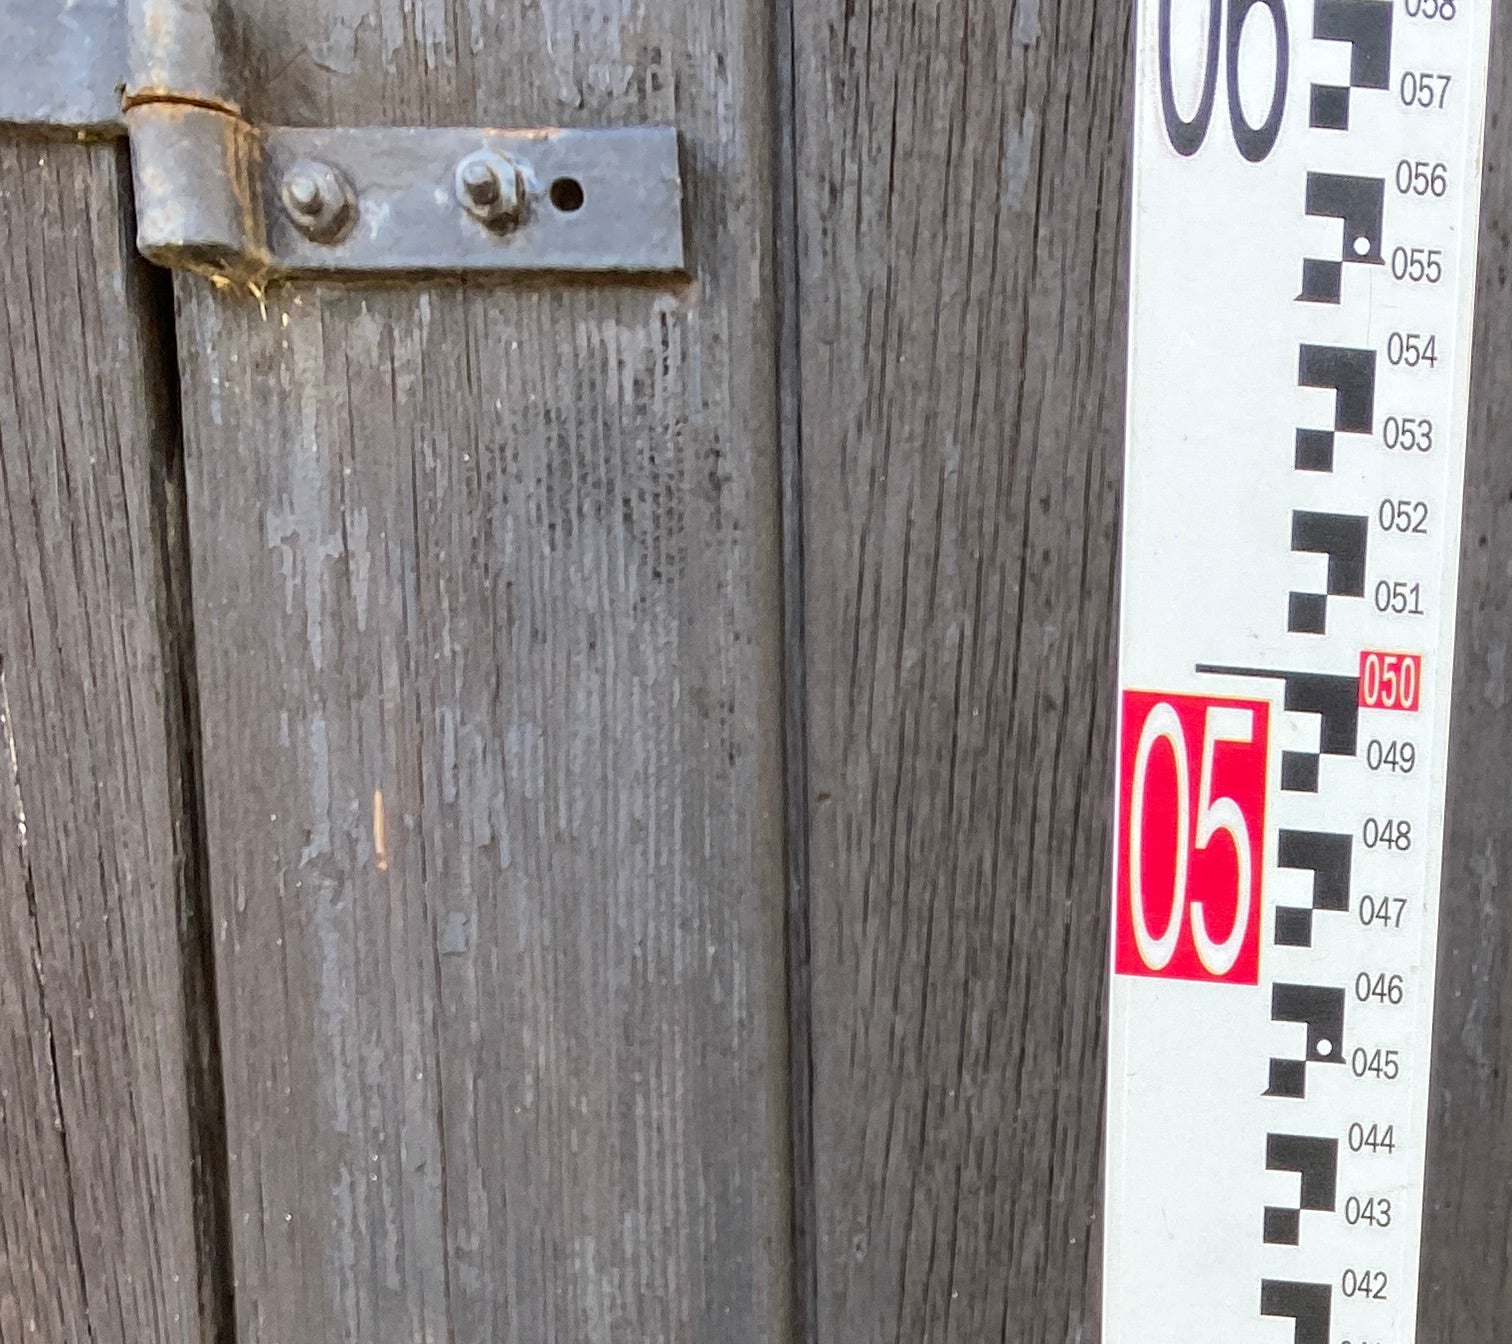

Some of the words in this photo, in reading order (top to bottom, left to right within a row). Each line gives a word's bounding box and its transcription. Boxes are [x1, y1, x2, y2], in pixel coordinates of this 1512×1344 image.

[1400, 71, 1451, 109] 057
[1396, 160, 1447, 197] 056
[1392, 246, 1441, 283] 055
[1387, 332, 1437, 368] 054
[1383, 416, 1432, 452] 053
[1379, 499, 1428, 534] 052
[1375, 580, 1423, 615] 051
[1362, 654, 1416, 707] 050
[1367, 739, 1415, 773] 049
[1132, 702, 1253, 973] 05
[1363, 818, 1411, 851] 048
[1359, 895, 1407, 928] 047
[1355, 972, 1403, 1004] 046
[1352, 1047, 1399, 1079] 045
[1349, 1122, 1395, 1154] 044
[1345, 1197, 1391, 1227] 043
[1342, 1269, 1387, 1299] 042
